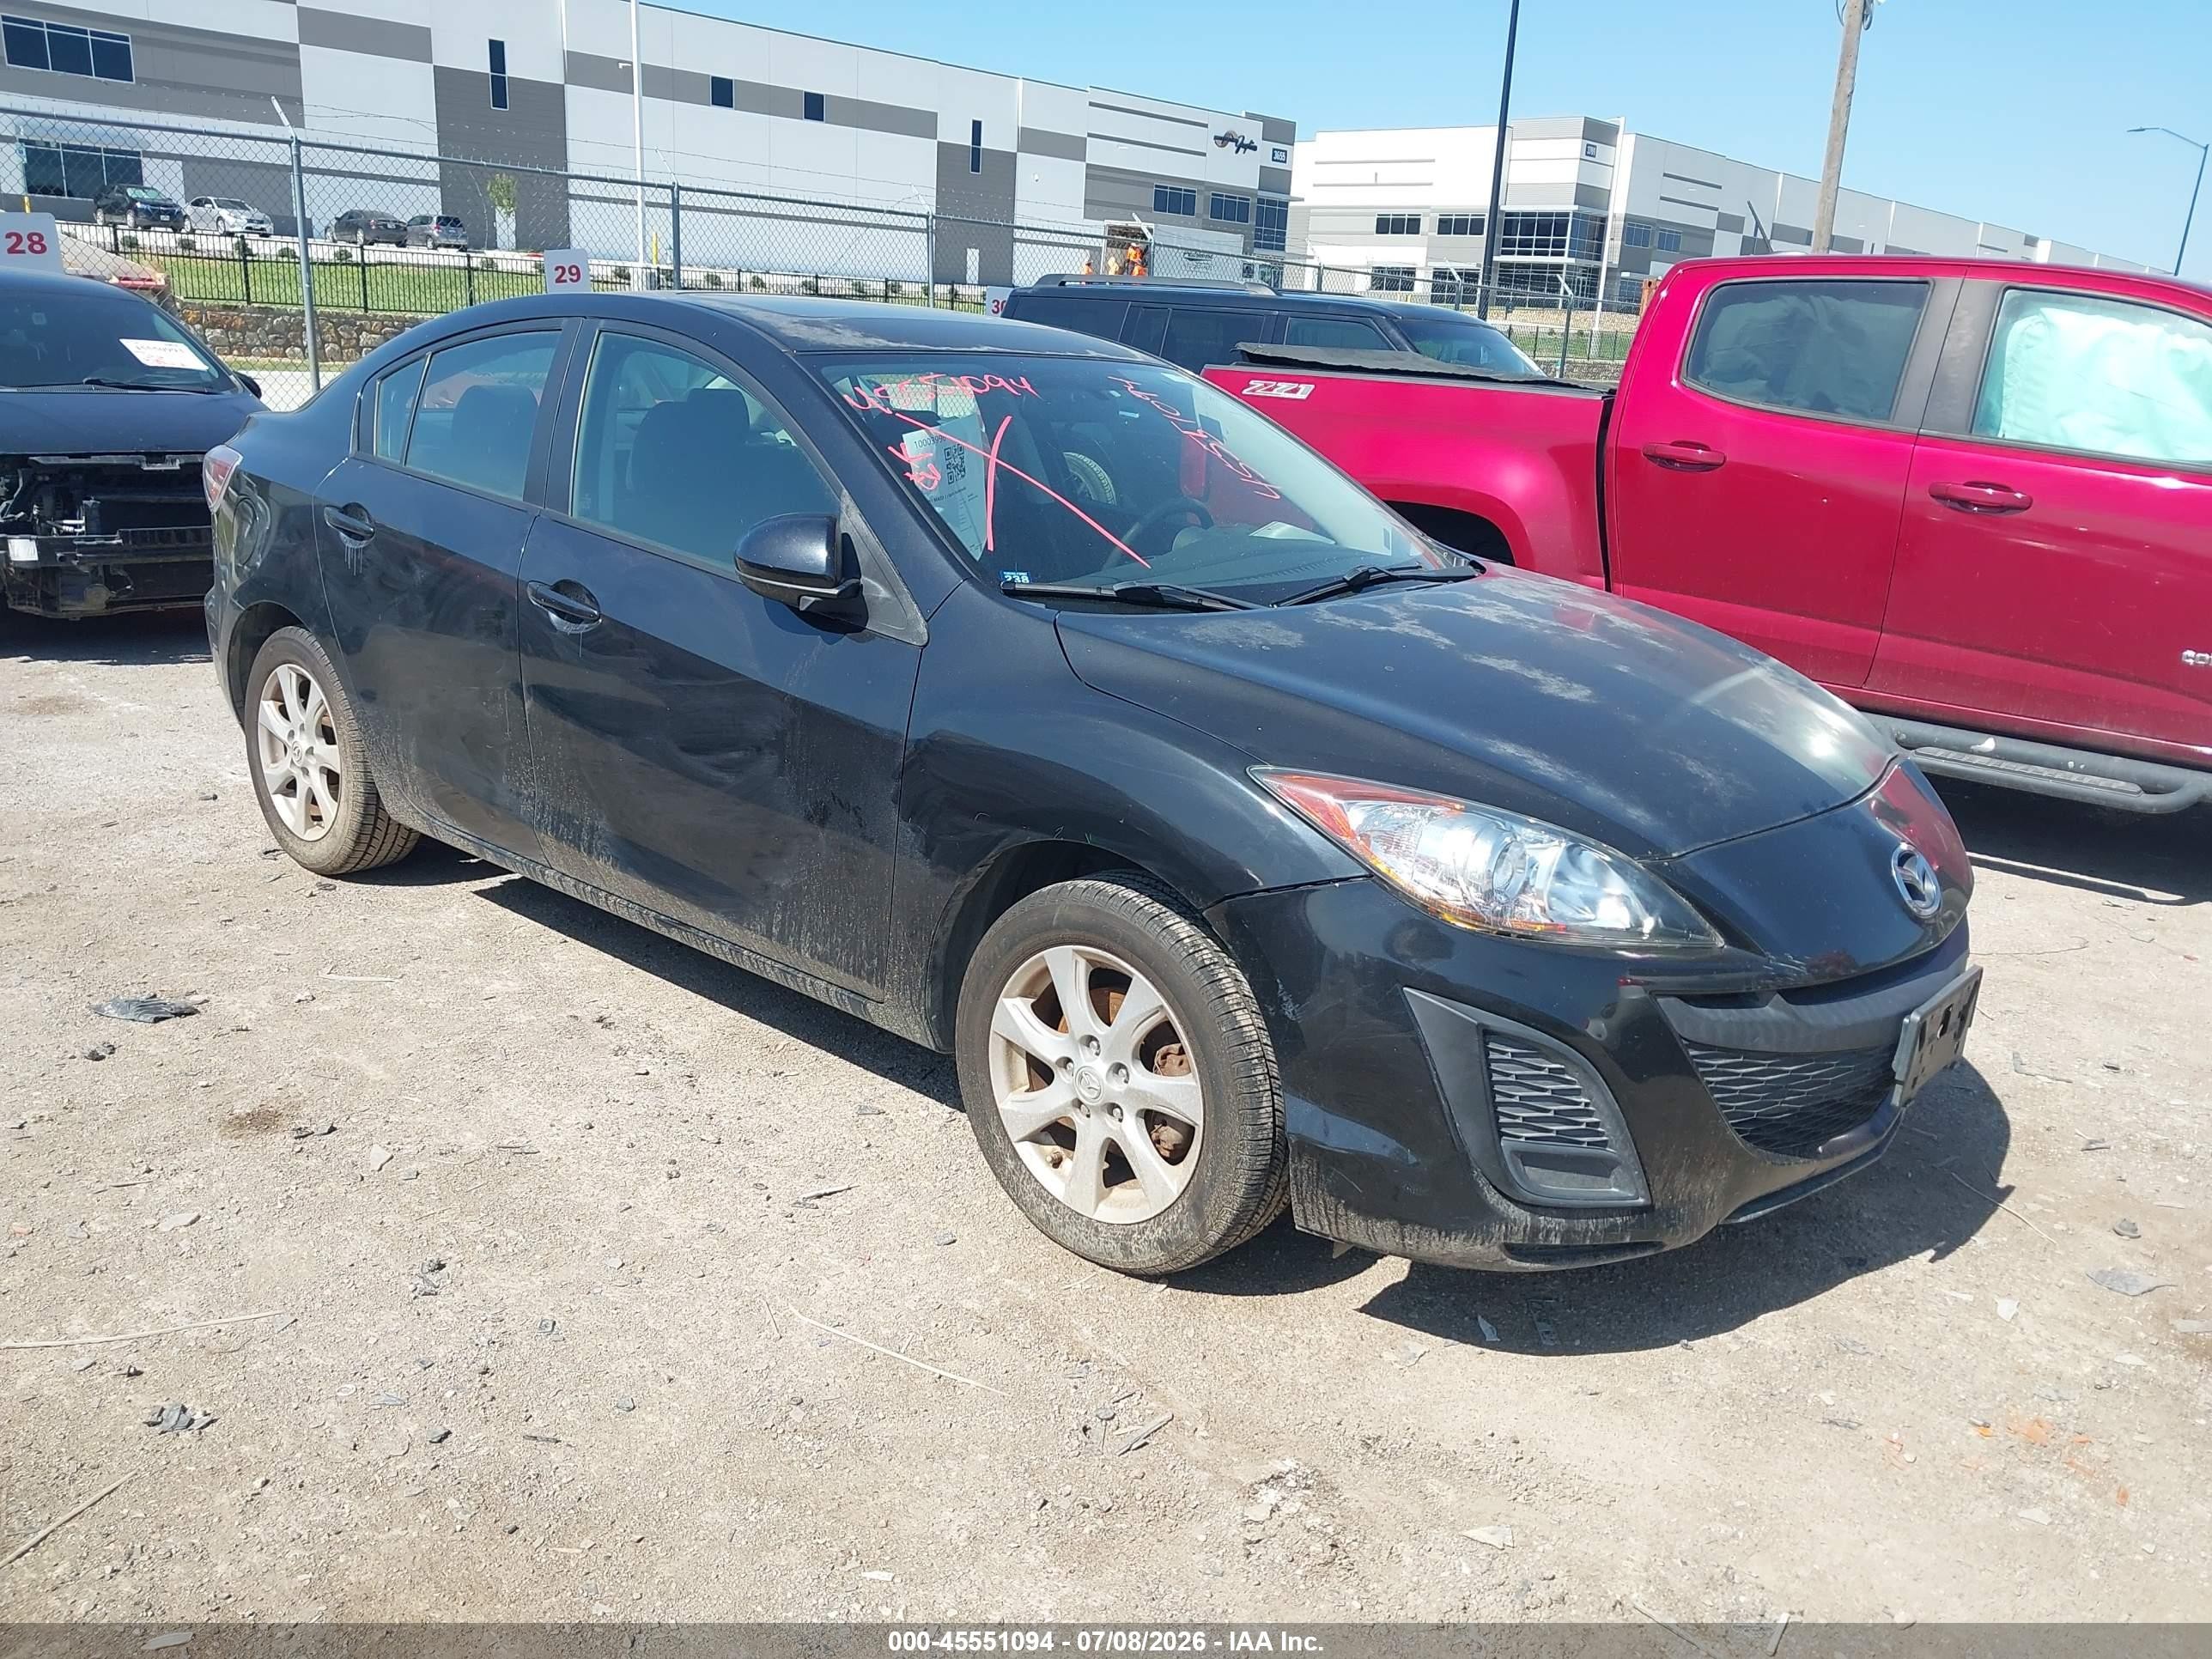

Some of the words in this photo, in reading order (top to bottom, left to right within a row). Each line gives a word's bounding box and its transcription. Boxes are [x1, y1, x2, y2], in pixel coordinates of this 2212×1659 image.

[5, 232, 47, 254] 28
[554, 264, 581, 283] 29
[1242, 380, 1316, 399] Z71
